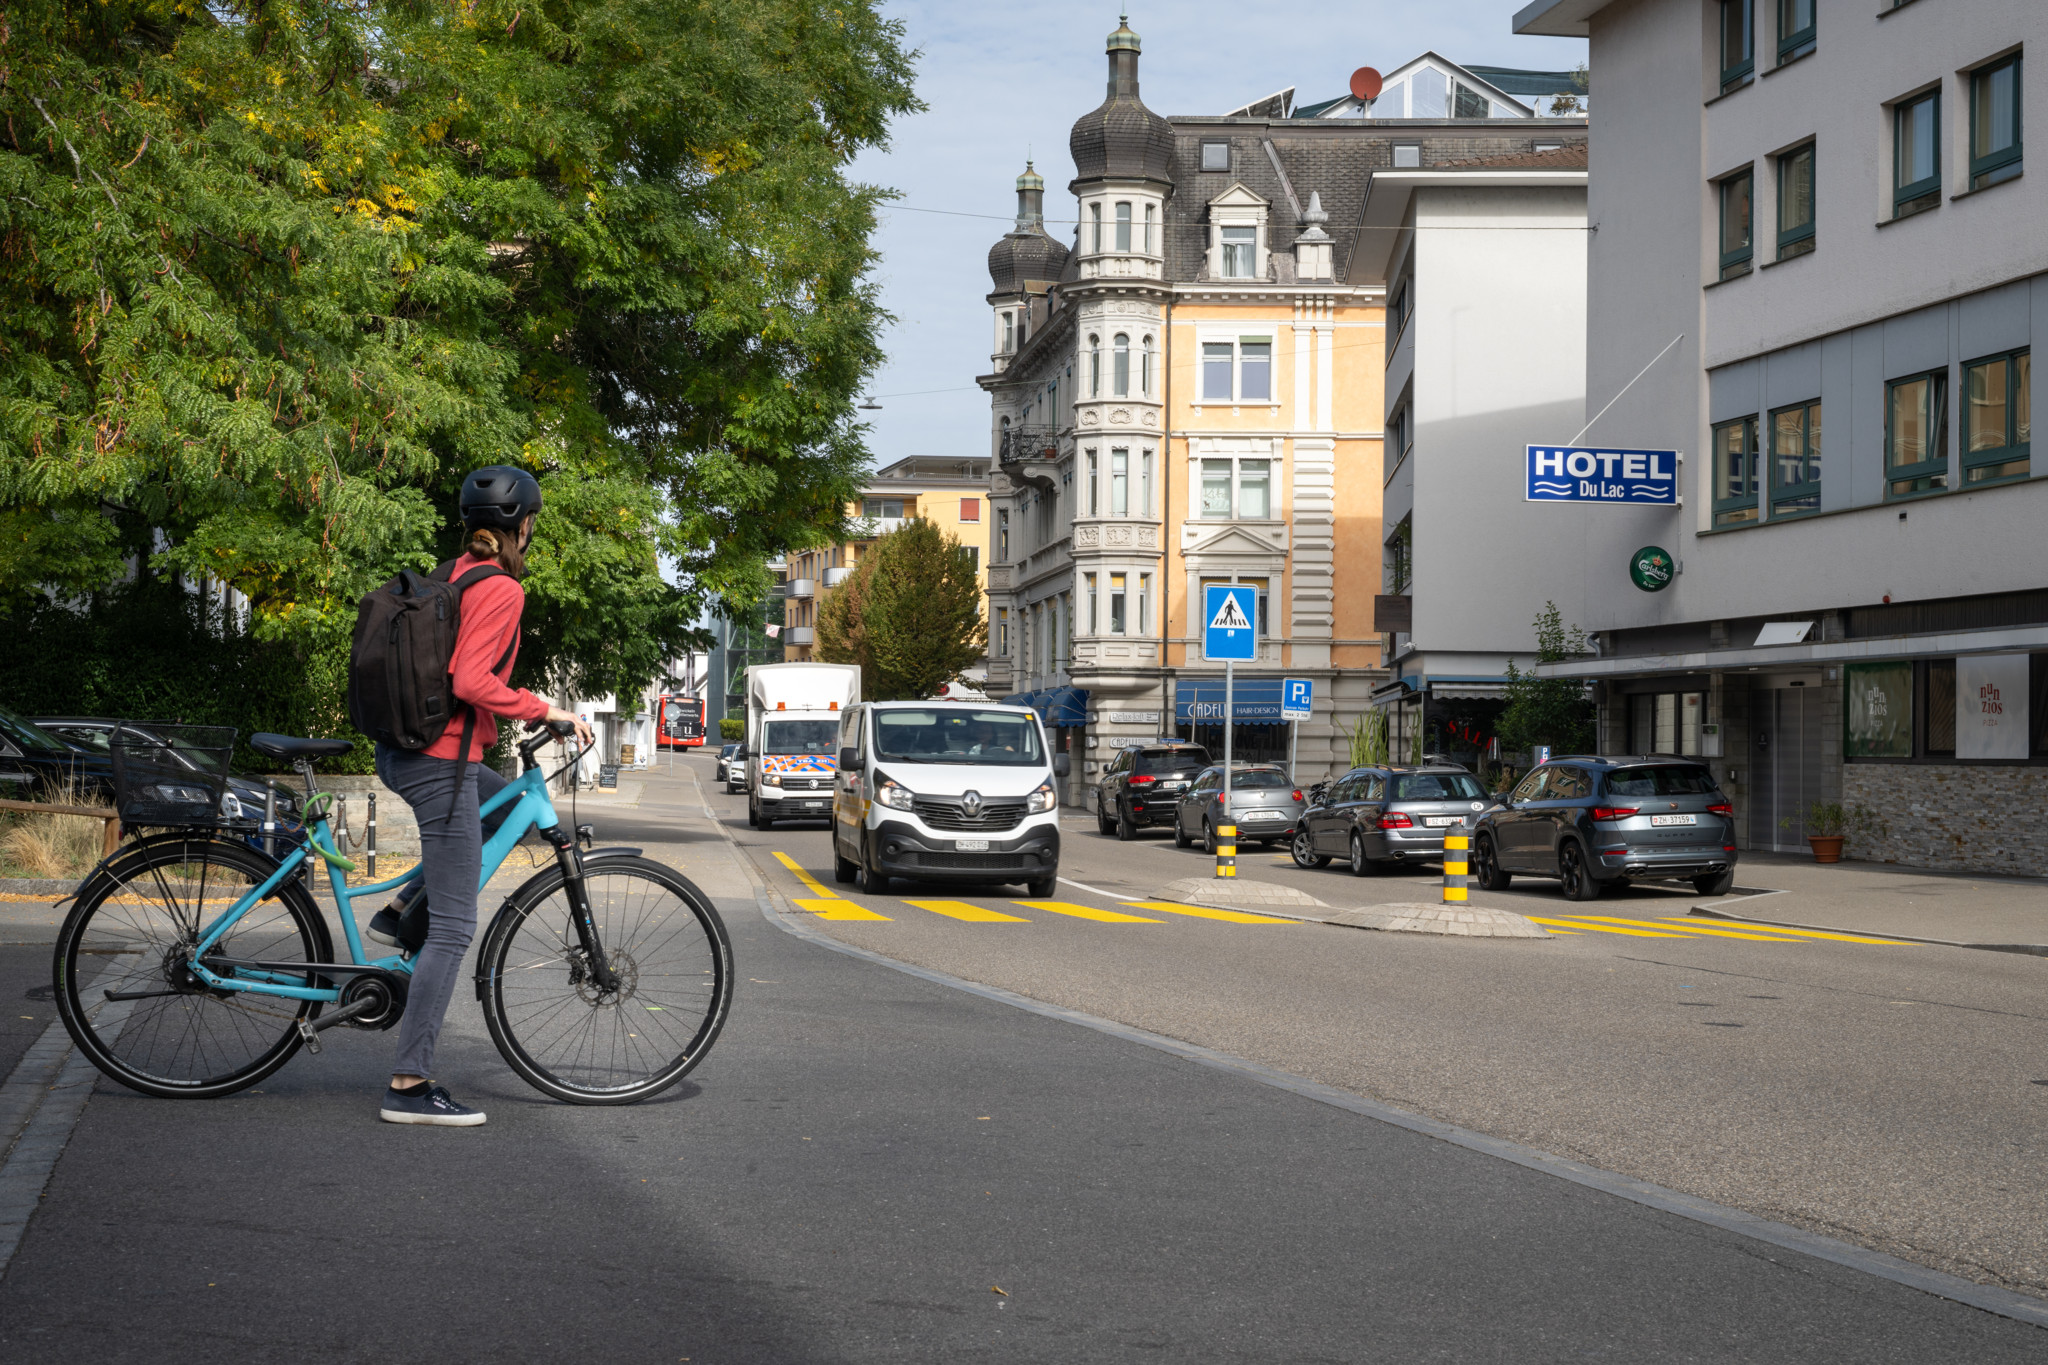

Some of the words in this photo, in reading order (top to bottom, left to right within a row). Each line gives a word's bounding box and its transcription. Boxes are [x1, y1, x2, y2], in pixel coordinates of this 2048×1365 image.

[1535, 450, 1672, 480] HOTEL
[1579, 480, 1597, 497] Du
[1601, 480, 1625, 498] Lac
[1638, 559, 1669, 581] Carlsberg
[1292, 682, 1305, 701] P
[1979, 682, 2000, 700] nun
[1187, 703, 1229, 718] CAPELL
[1236, 706, 1279, 714] HAIR-DESIGN
[1868, 700, 1888, 716] zios
[1981, 698, 2003, 715] zios
[1982, 719, 1998, 727] PIZZA
